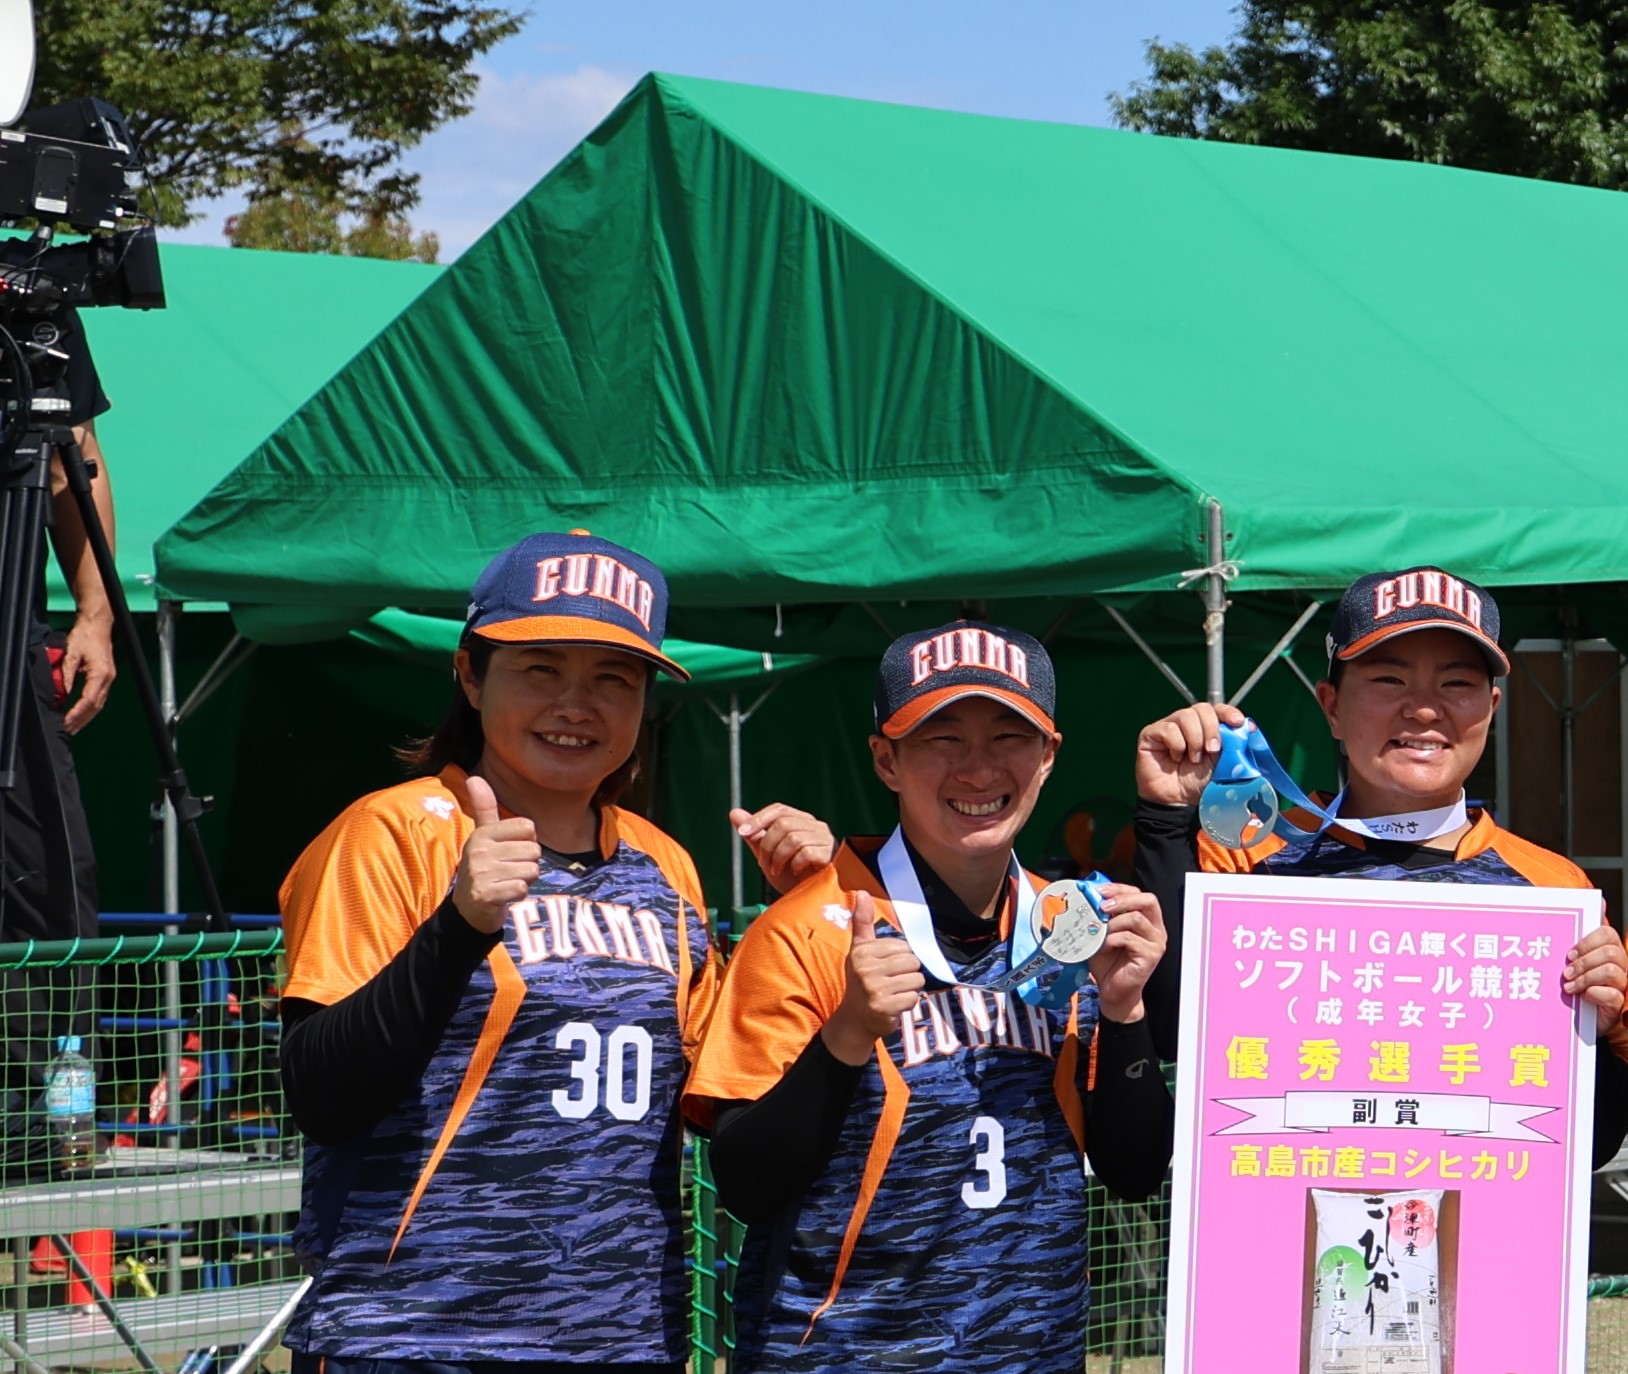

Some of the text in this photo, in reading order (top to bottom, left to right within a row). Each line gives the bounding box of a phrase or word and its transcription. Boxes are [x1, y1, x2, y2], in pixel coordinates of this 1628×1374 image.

[532, 552, 655, 632] GUNMA
[1373, 571, 1483, 634] GUNMA
[910, 629, 1031, 690] GUNMA
[509, 895, 676, 977] GUNMA
[1231, 925, 1553, 960] わたSHIGA輝く国スポ
[1233, 960, 1542, 1001] ソフトボール競技
[1286, 996, 1496, 1031] （成年女子）
[551, 1021, 654, 1122] 30
[1226, 1035, 1551, 1089] 優秀選手賞
[1352, 1099, 1421, 1127] 副賞
[962, 1116, 1007, 1209] 3
[1229, 1143, 1531, 1181] 高島市産コシヒカリ
